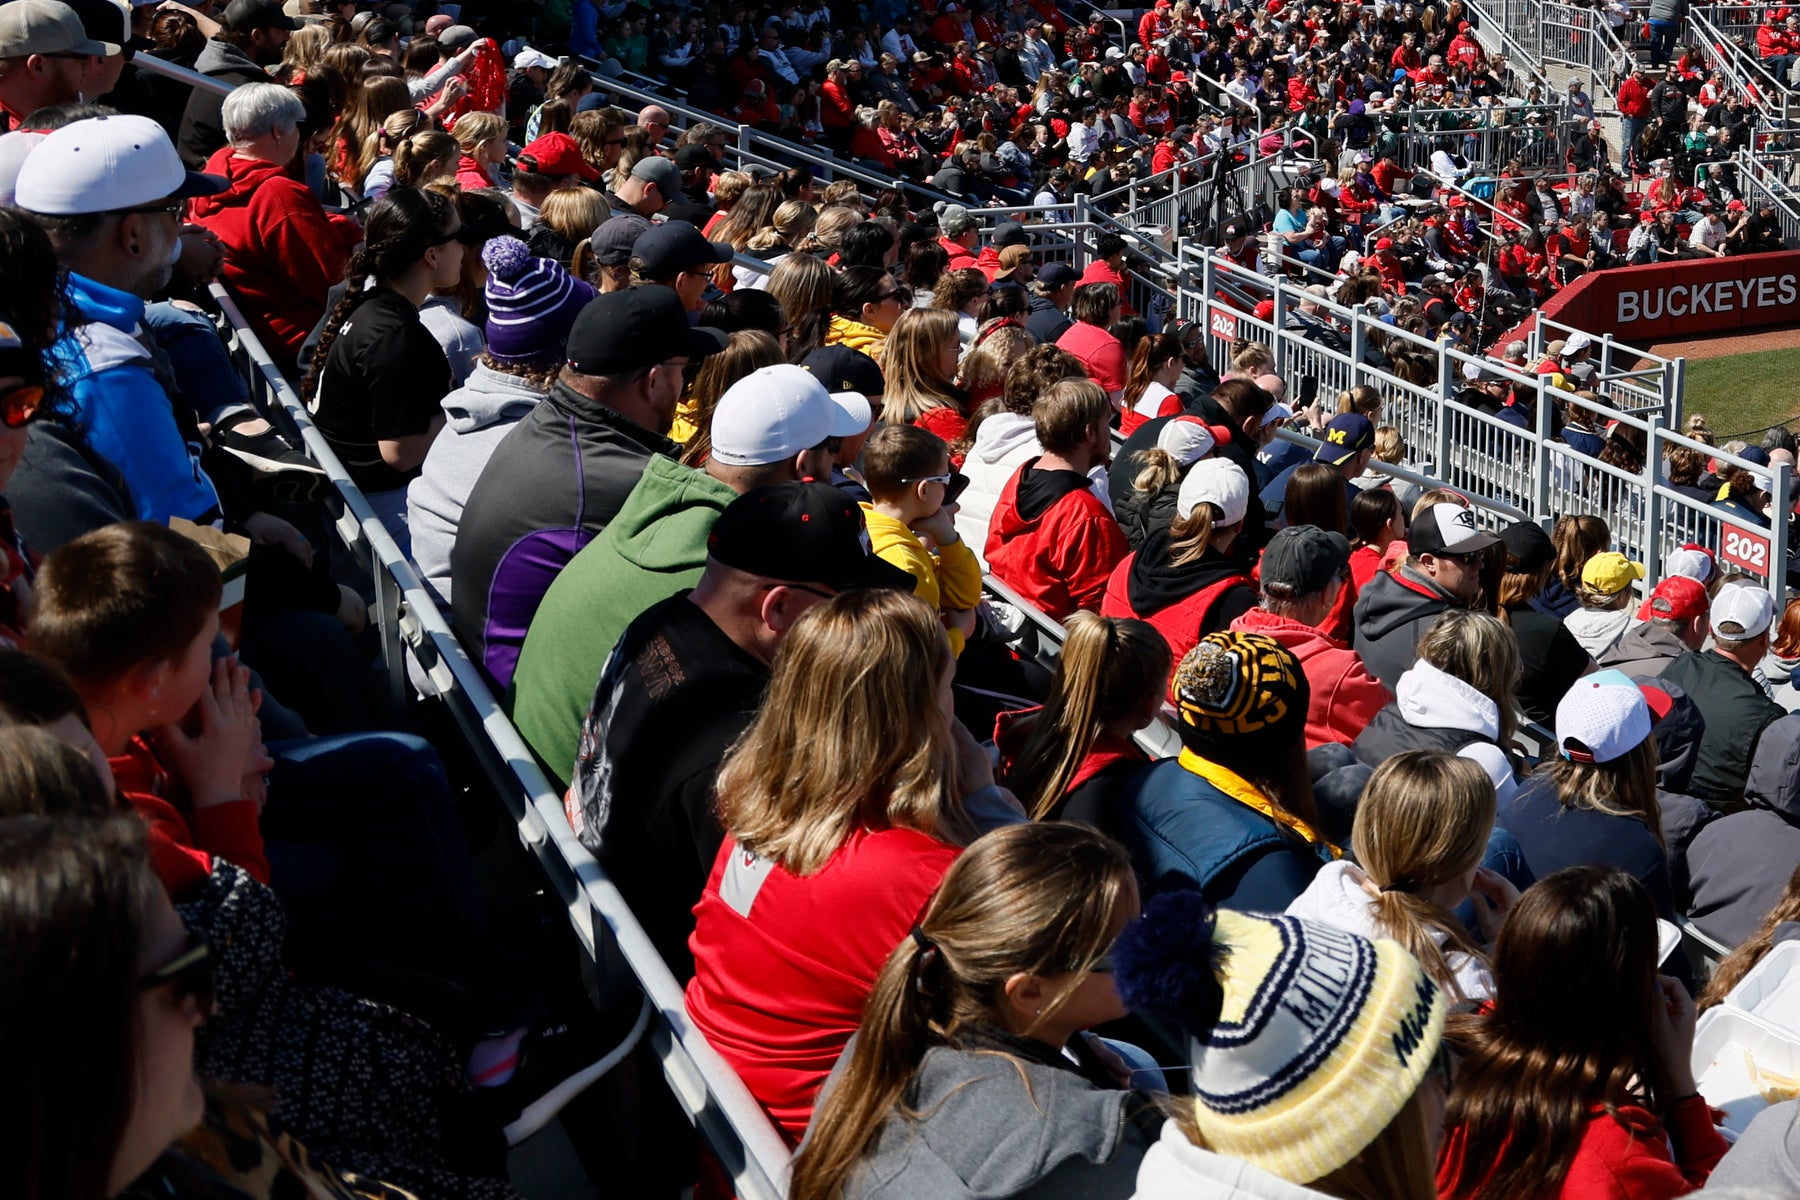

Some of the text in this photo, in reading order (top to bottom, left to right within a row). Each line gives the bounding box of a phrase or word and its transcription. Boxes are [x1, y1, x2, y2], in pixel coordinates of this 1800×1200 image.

[1617, 274, 1797, 323] BUCKEYES
[1212, 313, 1235, 338] 202
[1327, 428, 1347, 445] M
[1725, 532, 1766, 568] 202
